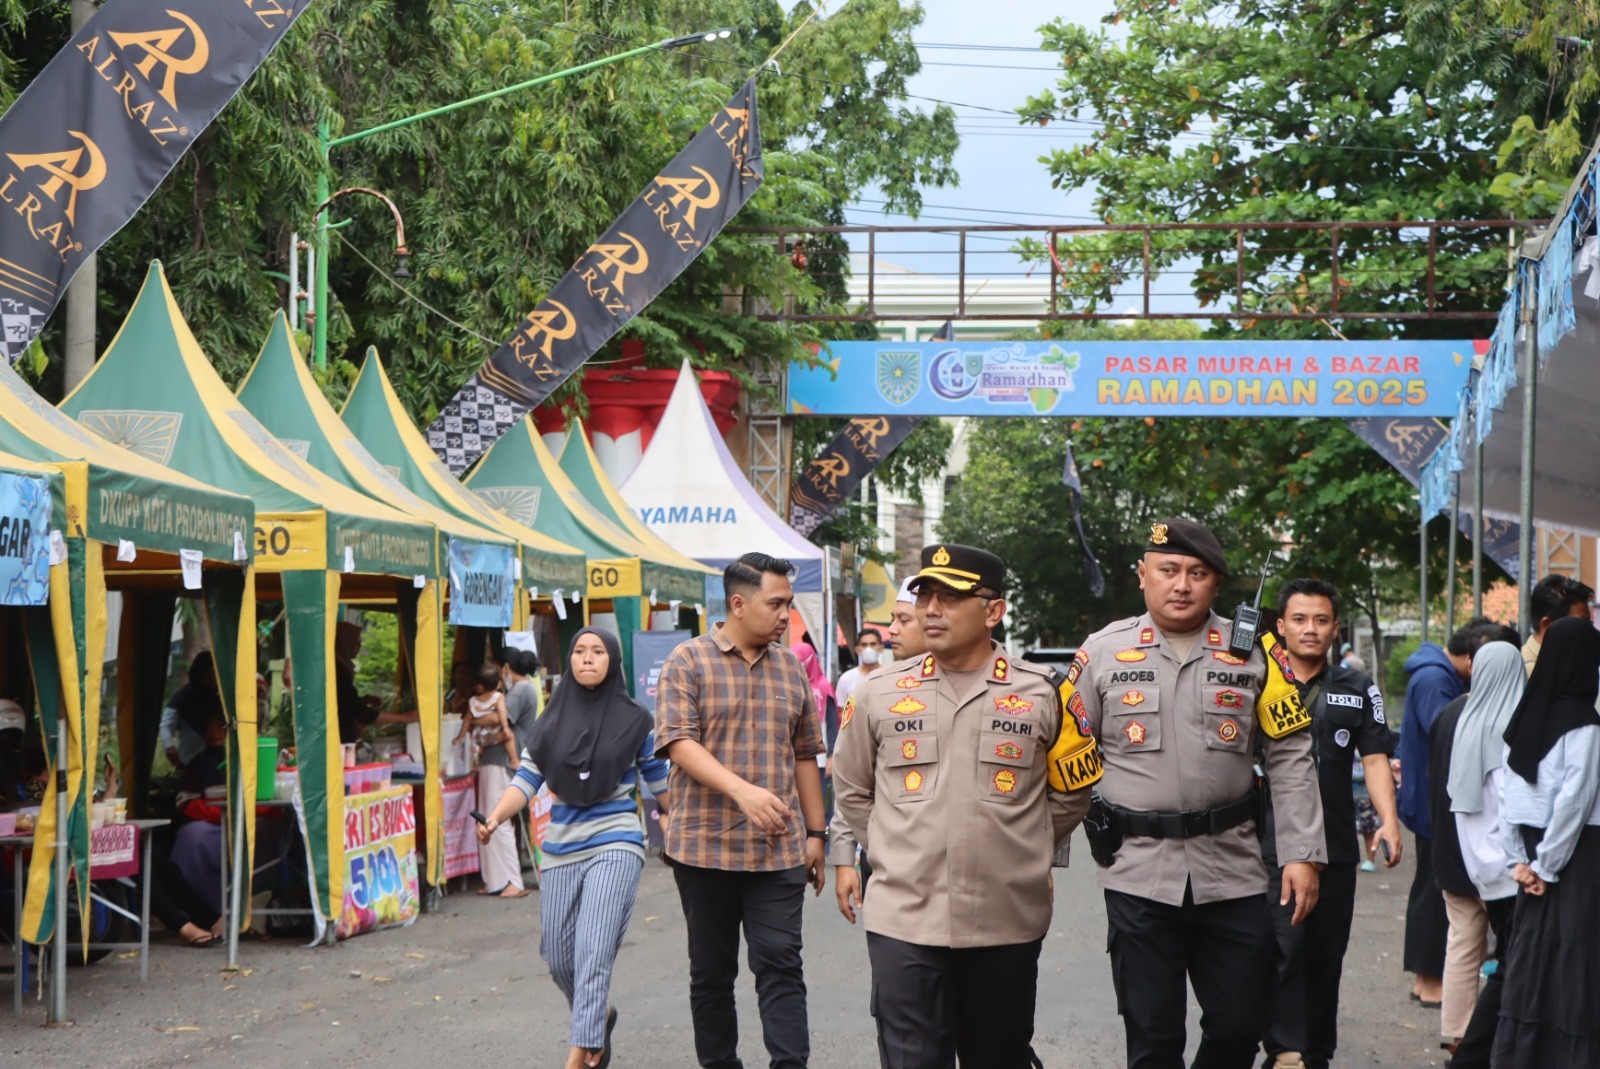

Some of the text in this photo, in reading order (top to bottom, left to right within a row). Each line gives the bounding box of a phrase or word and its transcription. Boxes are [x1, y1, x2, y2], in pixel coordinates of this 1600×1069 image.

[76, 36, 176, 147] ALRAZ
[1105, 356, 1421, 374] PASAR MURAH & BAZAR
[982, 372, 1067, 386] Ramadhan
[1097, 378, 1428, 405] RAMADHAN 2025
[100, 488, 141, 529] DKUPP
[143, 496, 173, 536] KOTA
[640, 506, 737, 524] YAMAHA
[254, 526, 291, 556] GO
[590, 567, 619, 587] GO
[1111, 670, 1155, 684] AGOES
[1206, 671, 1250, 687] POLRI
[1329, 694, 1362, 707] POLRI
[1268, 700, 1293, 723] KA
[894, 719, 923, 732] OKI
[992, 719, 1032, 736] POLRI
